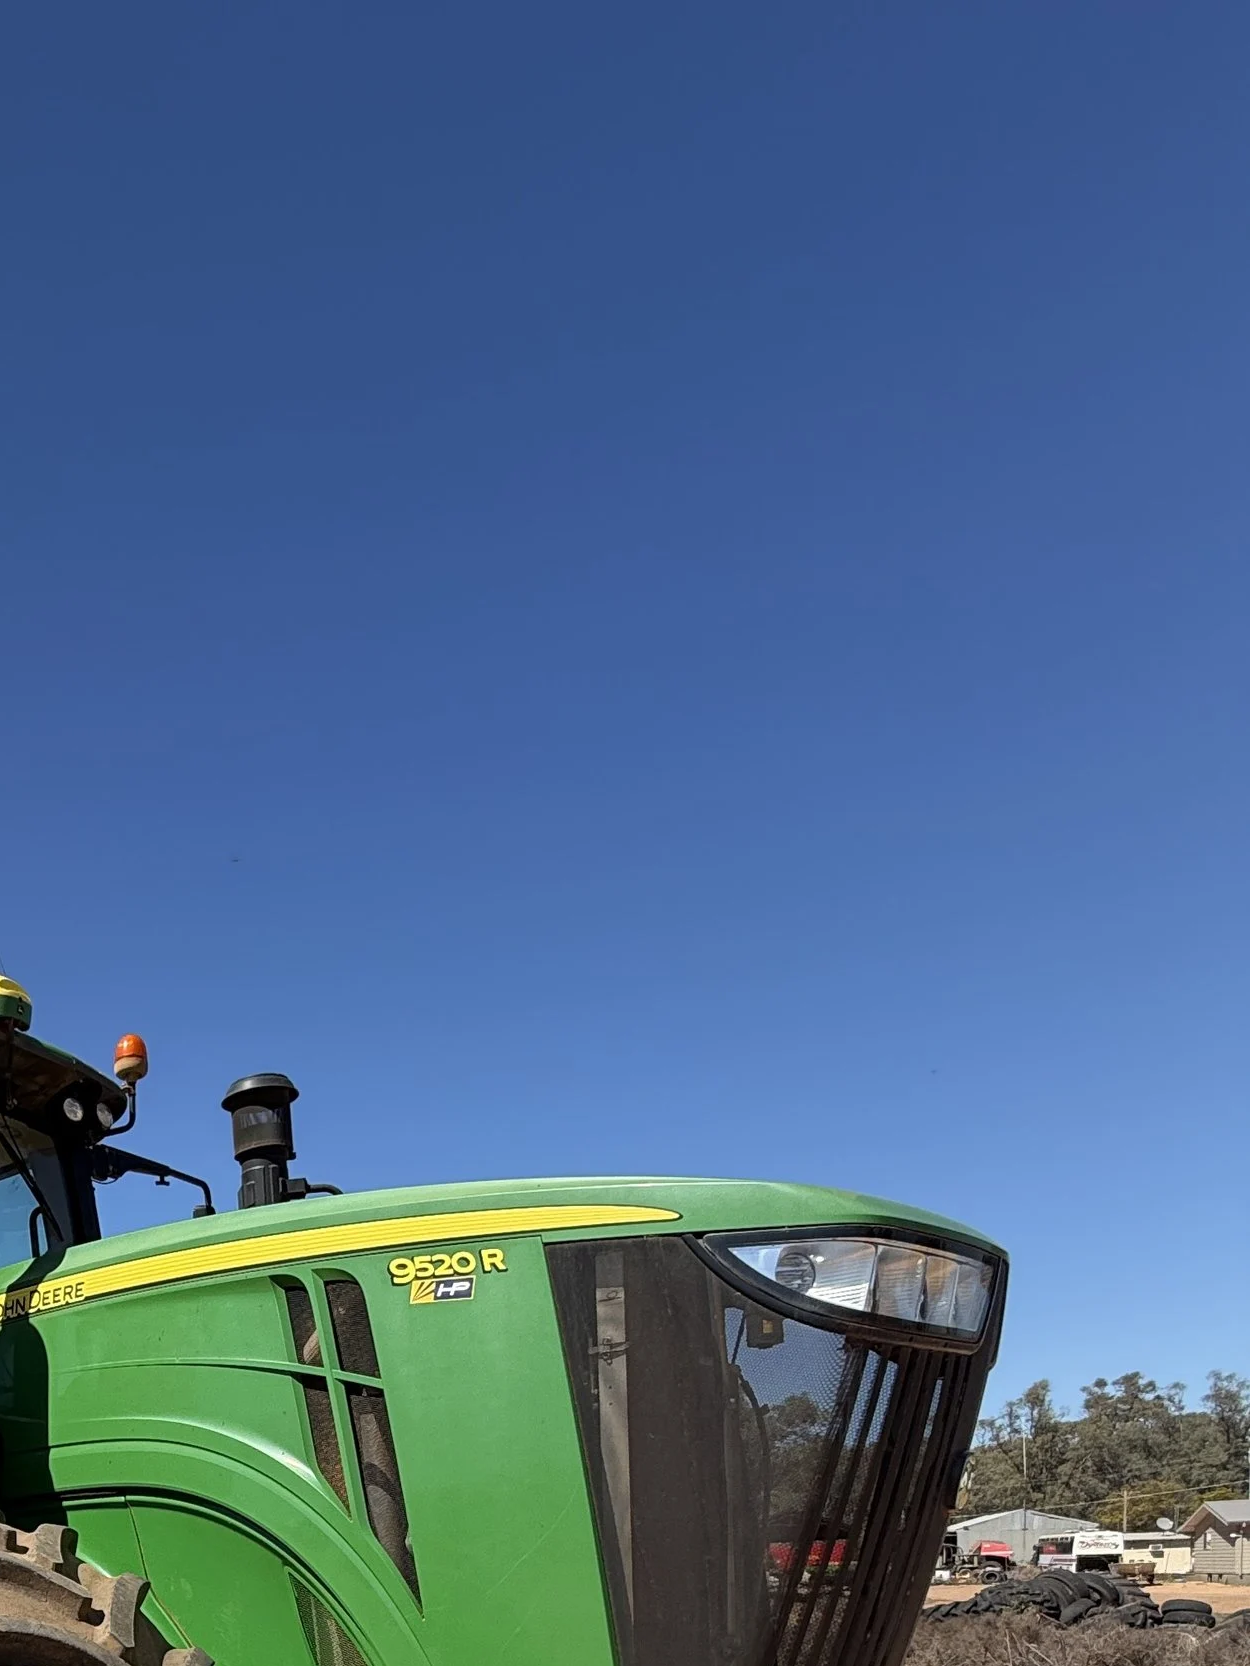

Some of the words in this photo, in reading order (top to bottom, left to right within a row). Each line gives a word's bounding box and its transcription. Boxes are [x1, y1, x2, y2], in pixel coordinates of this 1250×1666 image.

[388, 1251, 477, 1286] 9520
[479, 1248, 508, 1273] R
[30, 1281, 85, 1310] DEERE
[436, 1281, 471, 1298] HP
